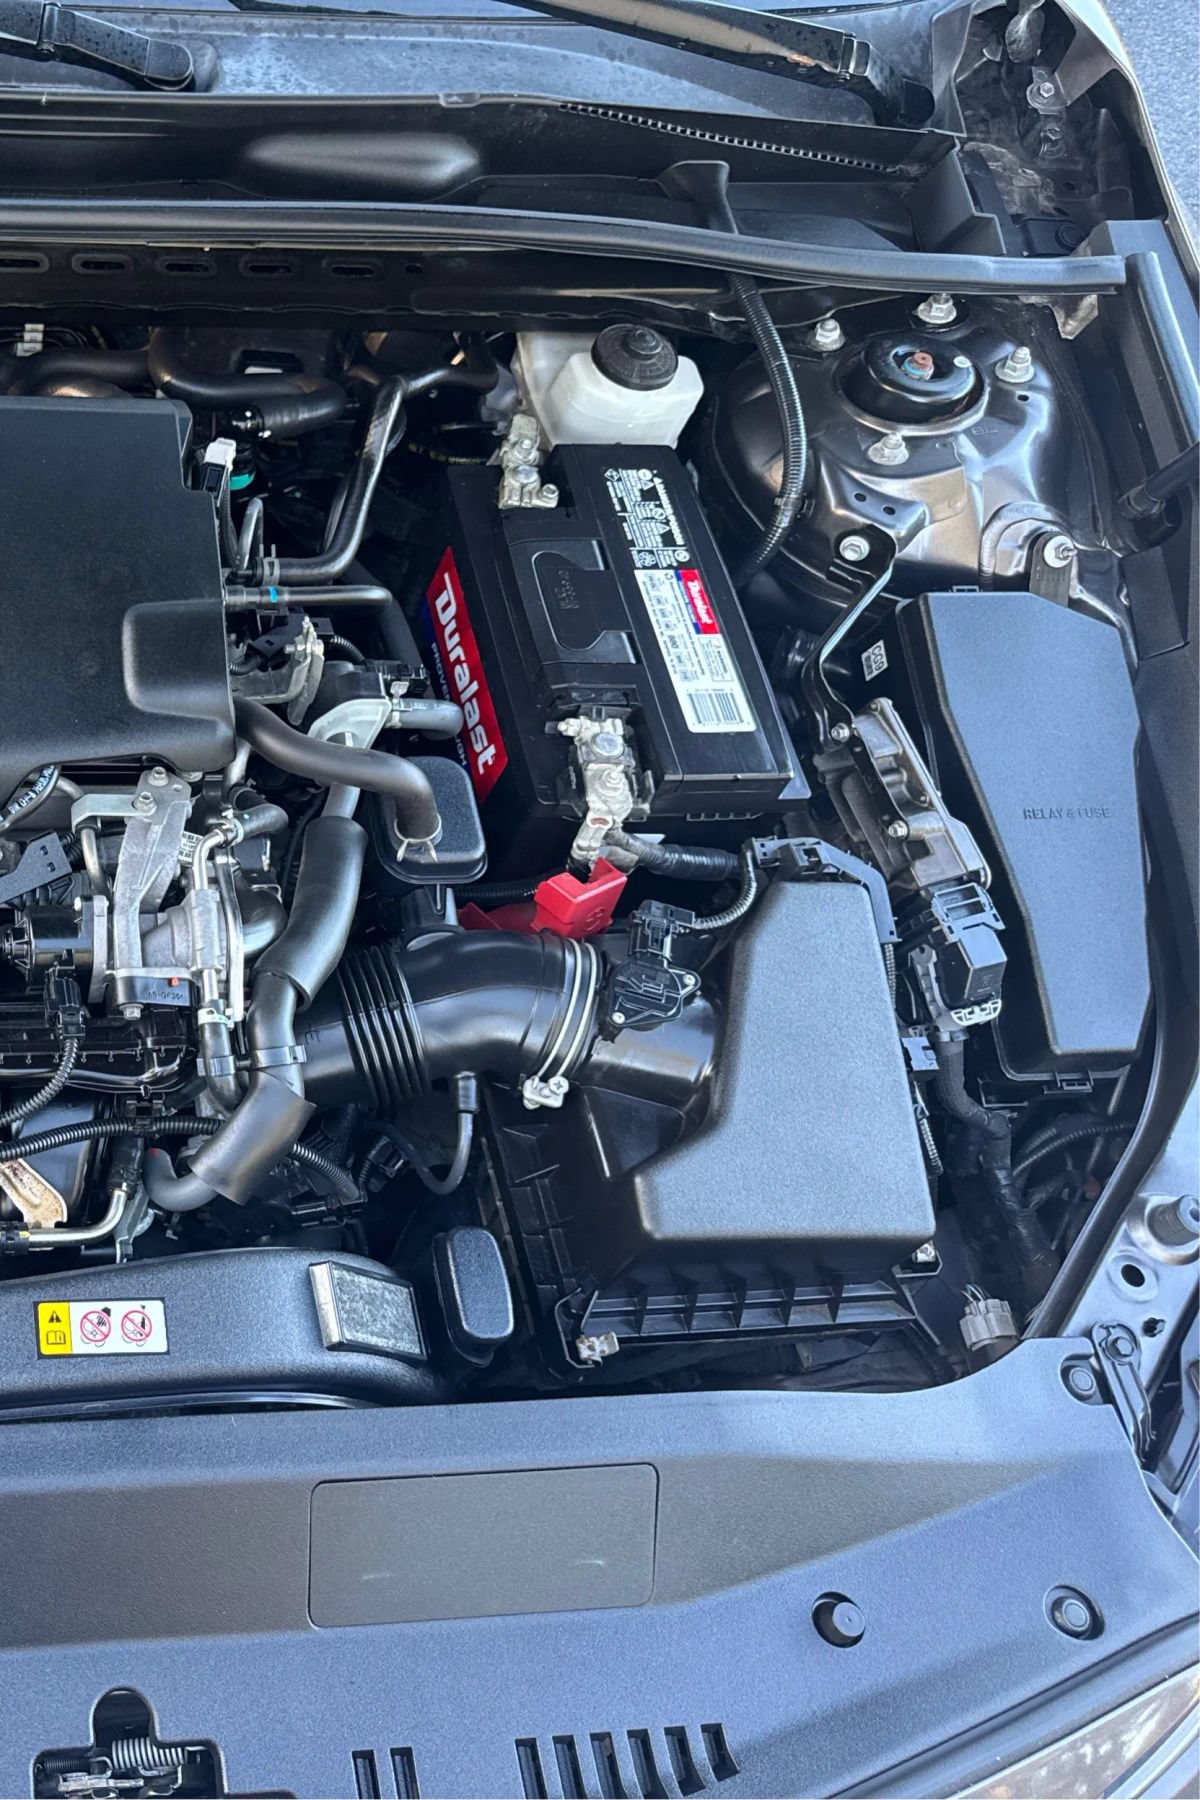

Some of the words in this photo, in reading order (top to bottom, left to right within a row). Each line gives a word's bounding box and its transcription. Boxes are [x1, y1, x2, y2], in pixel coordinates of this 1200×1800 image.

[871, 644, 885, 672] CG9
[435, 571, 497, 775] Duralast
[1023, 807, 1063, 820] RELAY
[1066, 807, 1076, 819] &
[1077, 807, 1112, 819] FUSE
